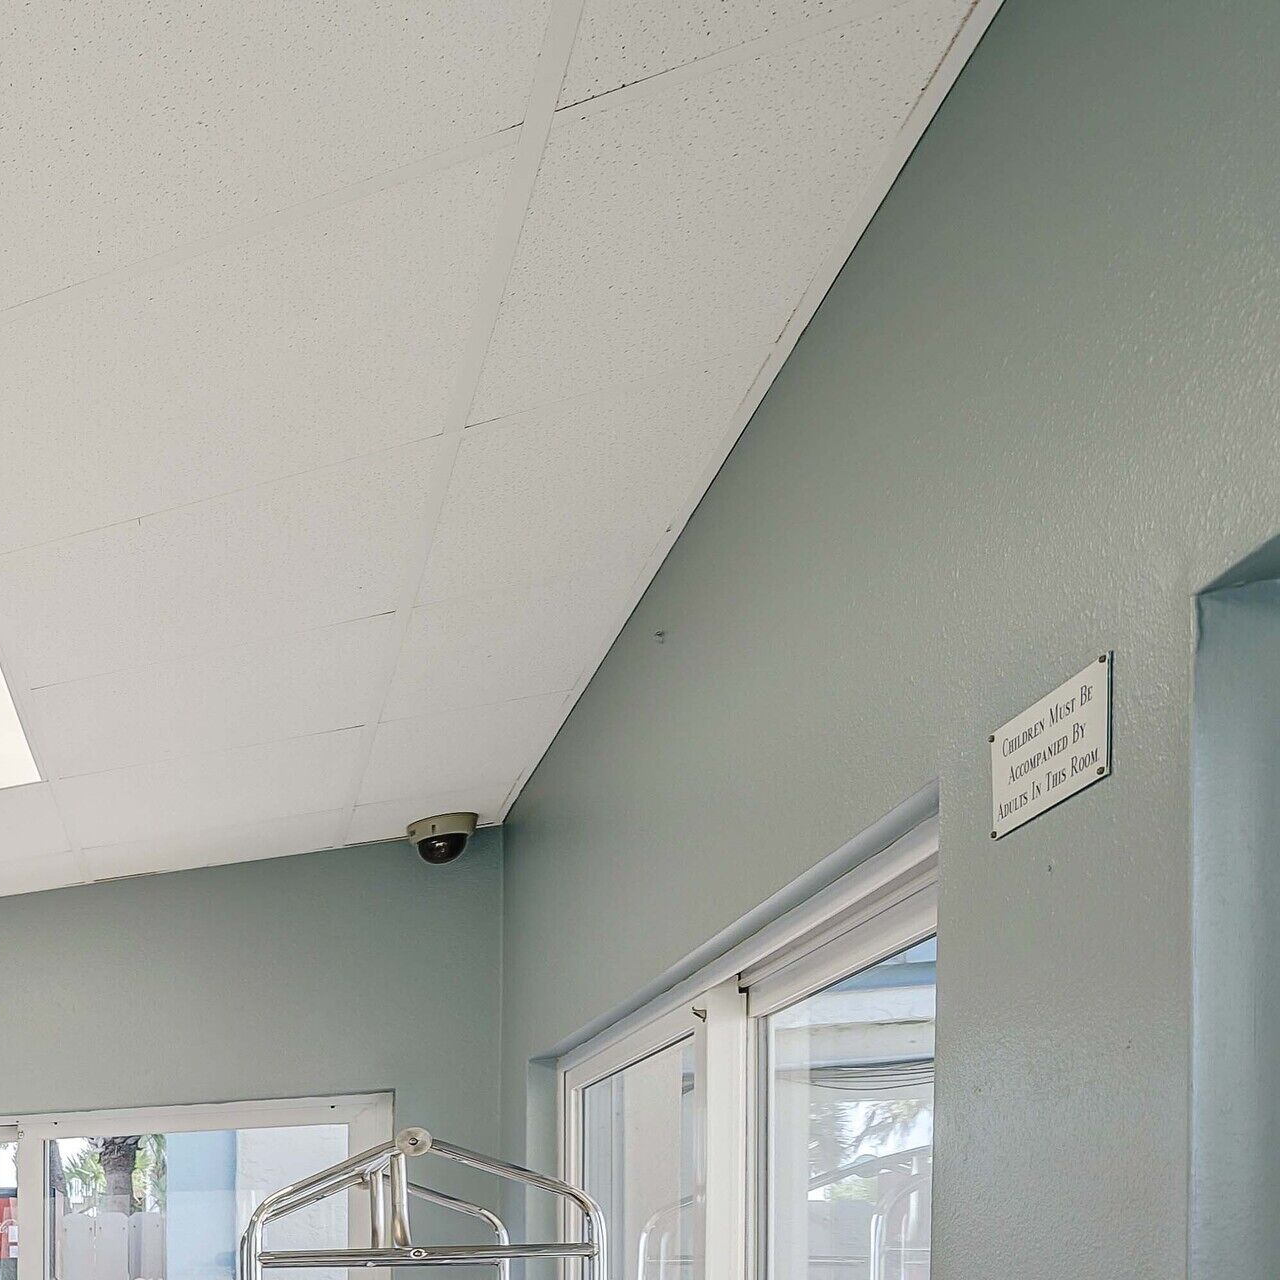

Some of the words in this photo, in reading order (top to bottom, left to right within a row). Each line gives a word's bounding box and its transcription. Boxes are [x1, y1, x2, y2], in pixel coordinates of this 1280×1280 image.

[1002, 718, 1045, 758] CHILDREN
[1049, 697, 1075, 728] MUST
[1080, 684, 1094, 707] BE
[1008, 737, 1068, 786] ACCOMPANIED
[1072, 722, 1086, 745] BY
[997, 793, 1028, 823] ADULTS
[1031, 779, 1042, 801] IN
[1046, 768, 1067, 792] THIS
